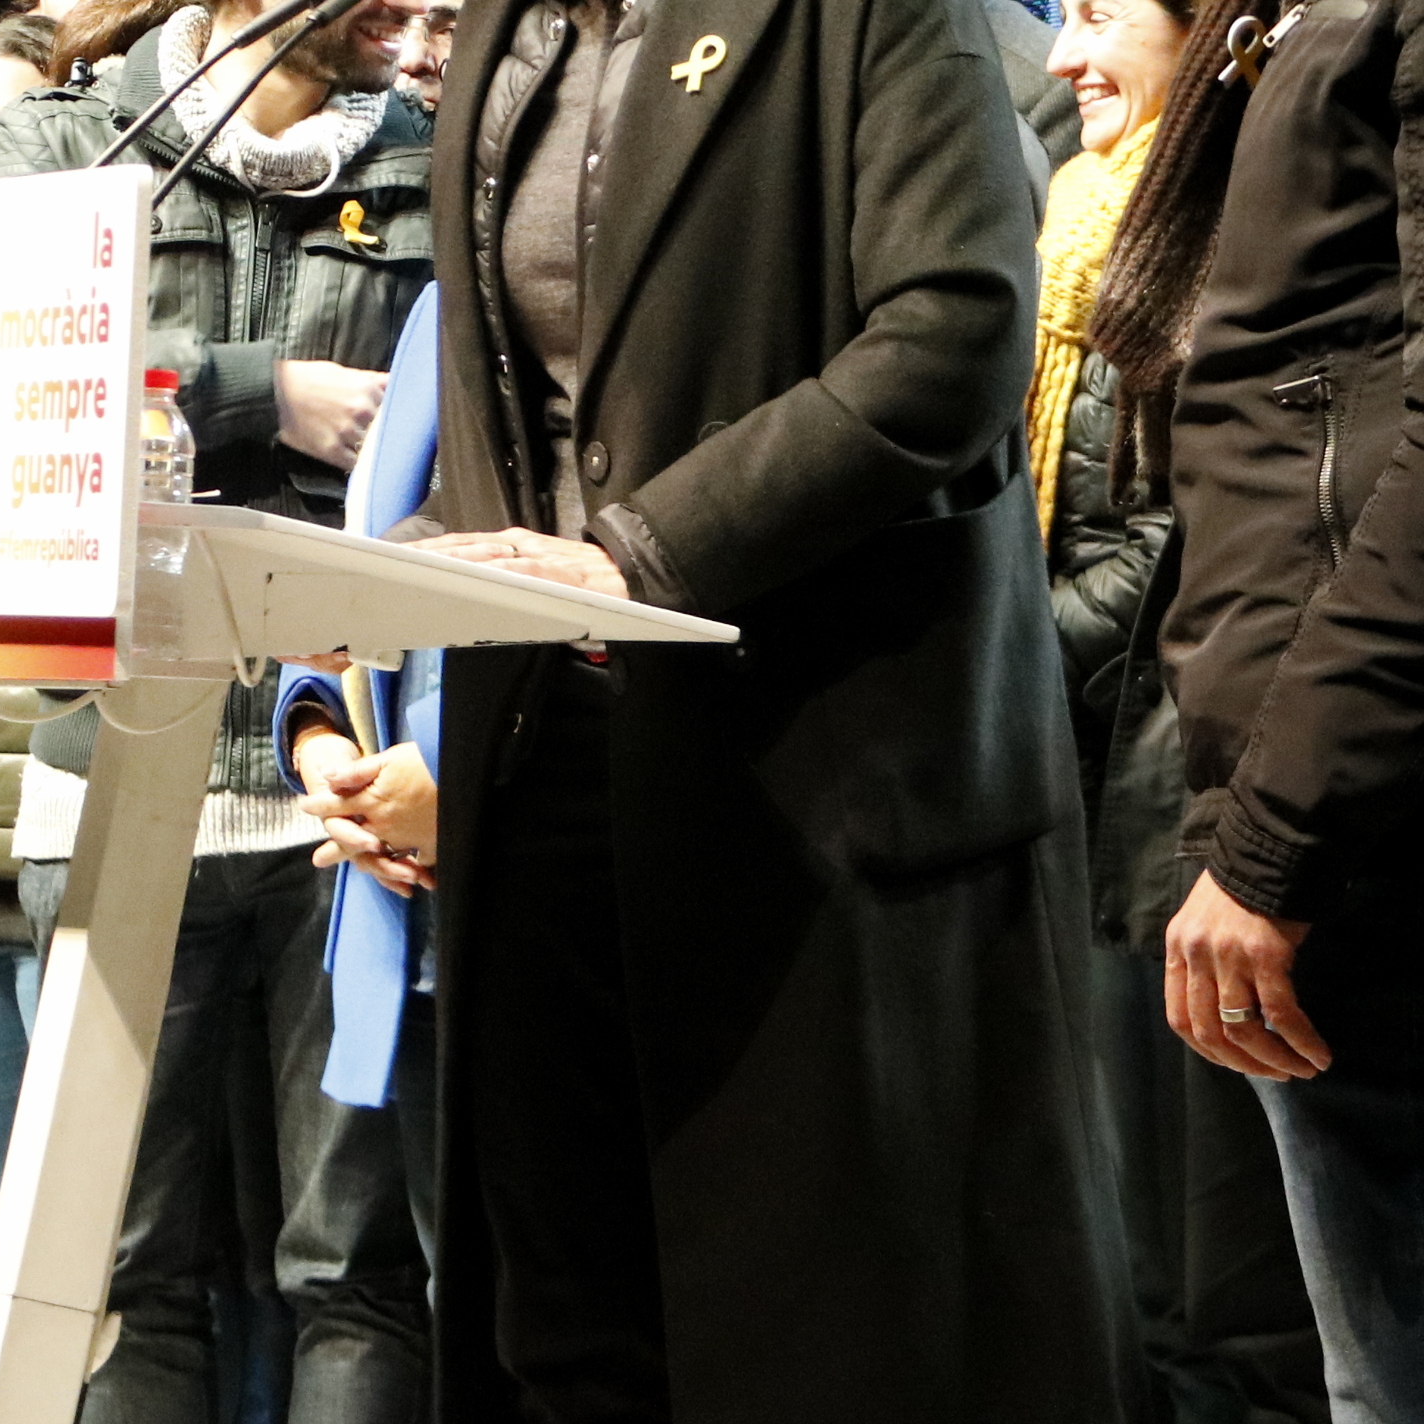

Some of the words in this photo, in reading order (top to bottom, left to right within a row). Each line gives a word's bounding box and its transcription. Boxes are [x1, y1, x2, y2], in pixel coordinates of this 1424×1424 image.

[92, 211, 113, 268] la
[14, 377, 107, 433] sempre
[11, 452, 103, 509] guanya
